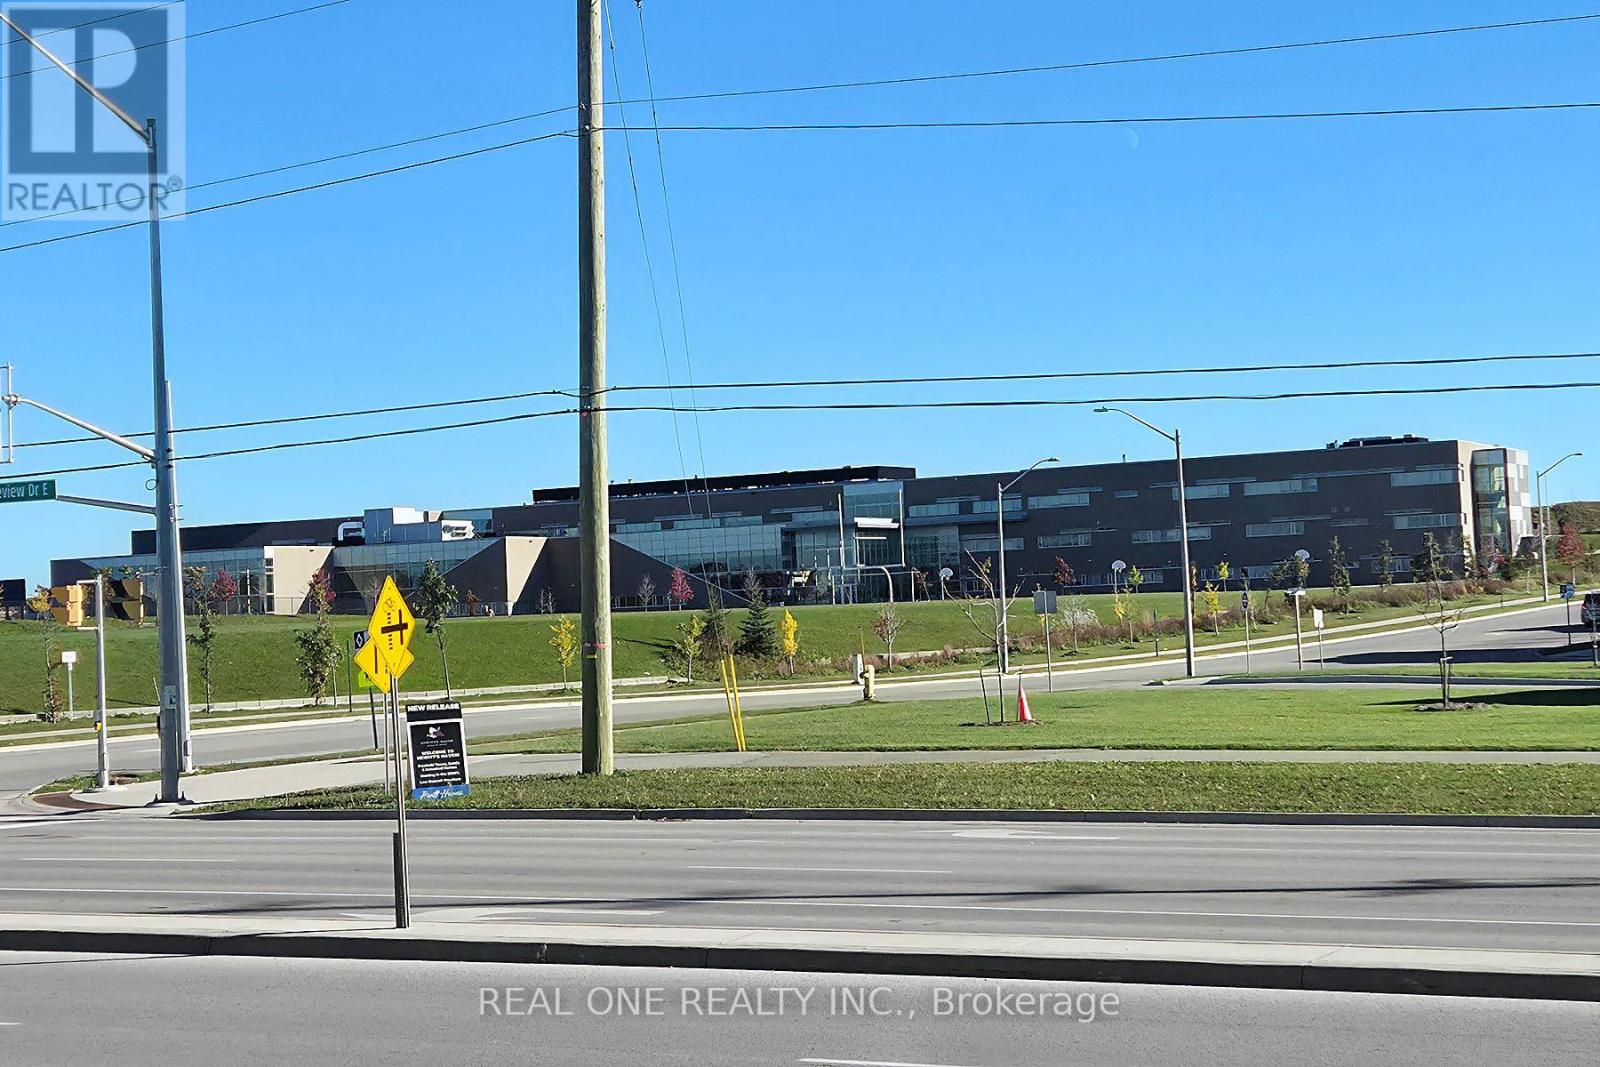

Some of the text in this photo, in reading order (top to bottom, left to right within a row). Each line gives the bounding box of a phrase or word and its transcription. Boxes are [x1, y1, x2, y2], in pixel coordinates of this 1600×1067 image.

[28, 483, 40, 497] Dr
[42, 482, 49, 496] E
[407, 702, 460, 712] NEW RELEASE
